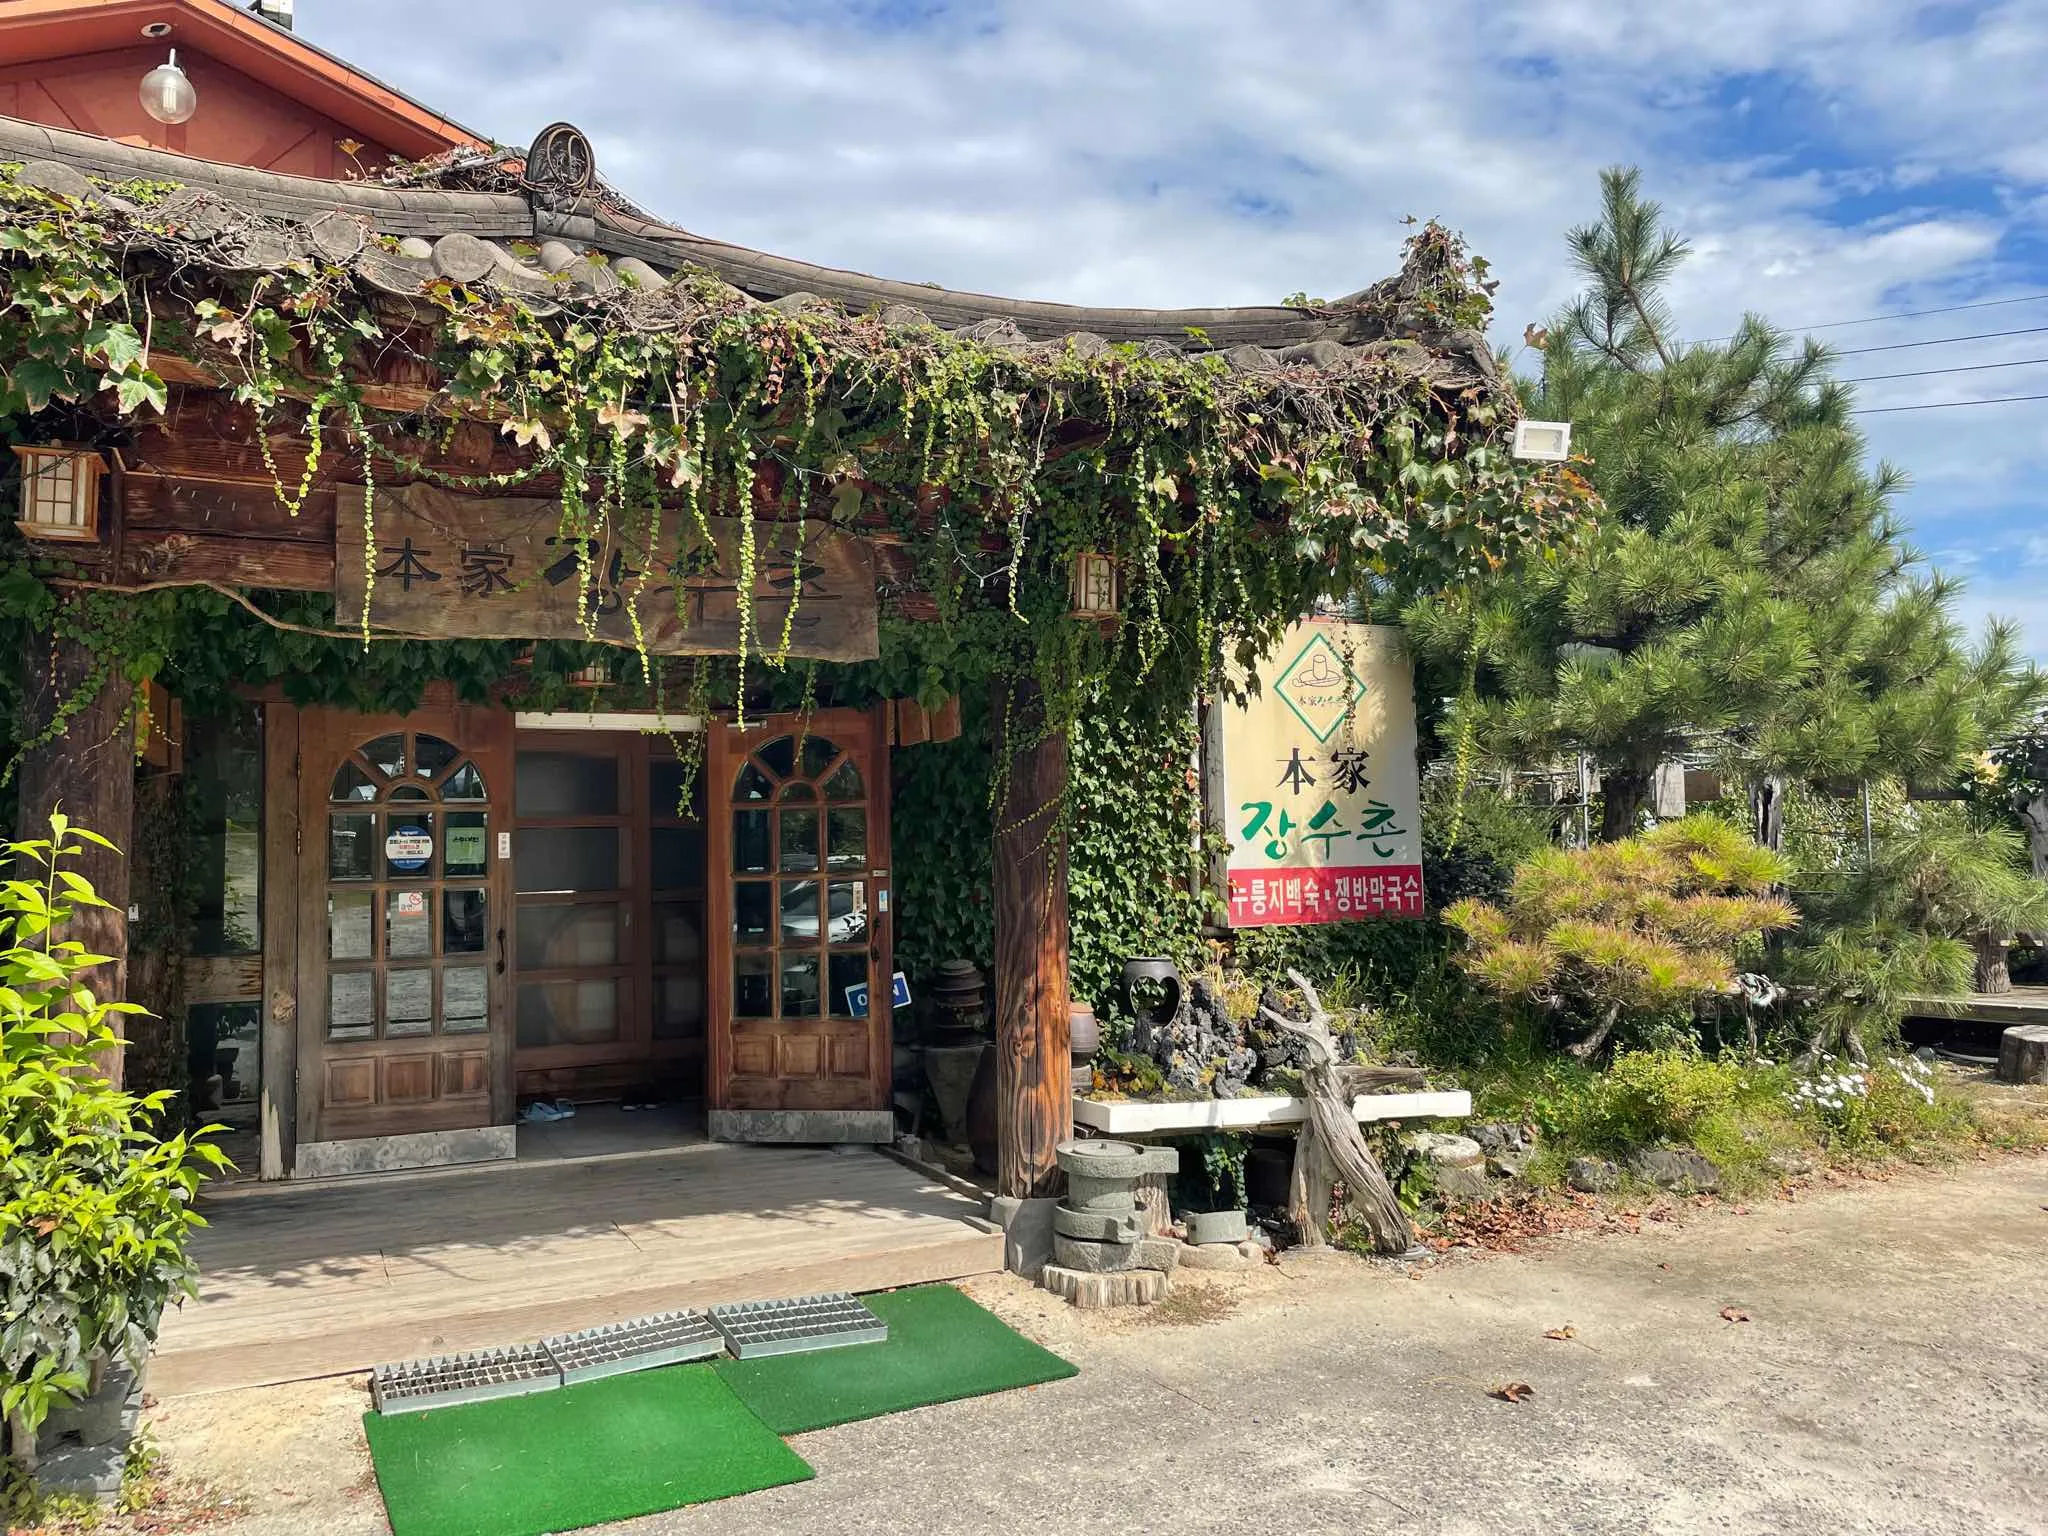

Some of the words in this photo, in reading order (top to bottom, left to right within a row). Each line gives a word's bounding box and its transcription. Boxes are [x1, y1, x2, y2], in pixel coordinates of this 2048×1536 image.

[375, 537, 516, 598] 本家
[1276, 747, 1371, 795] 本家
[1241, 800, 1407, 860] 장수촌
[1335, 875, 1419, 912] 쟁반막국수
